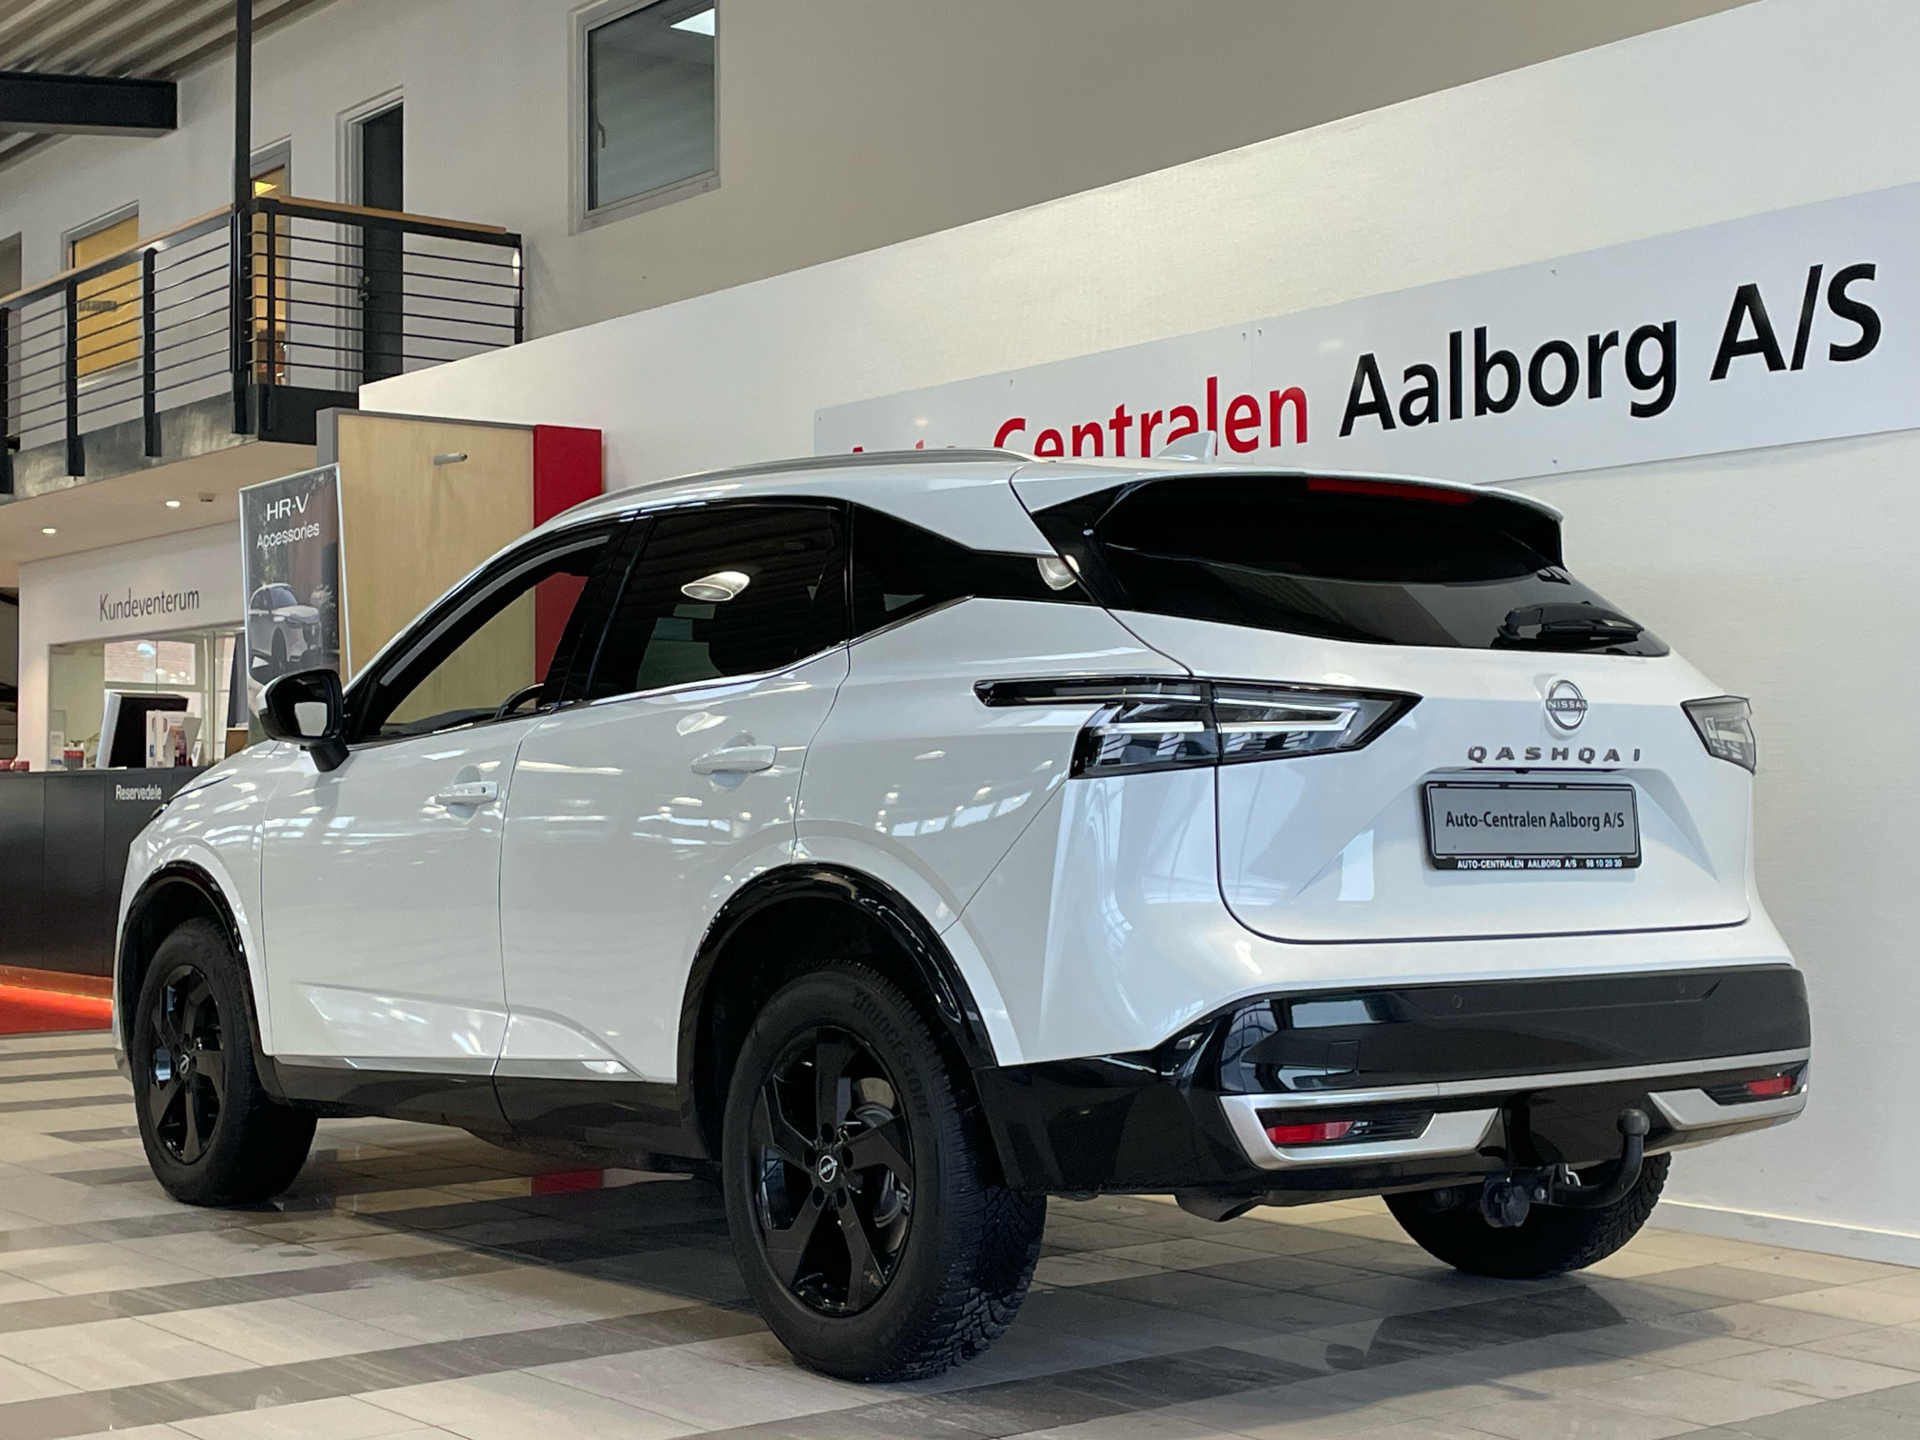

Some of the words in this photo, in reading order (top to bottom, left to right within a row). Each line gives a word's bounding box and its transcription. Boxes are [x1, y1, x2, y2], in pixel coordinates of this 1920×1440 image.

[1338, 319, 1677, 437] Aalborg
[1709, 263, 1882, 381] A/S
[266, 492, 309, 521] HR-V
[256, 522, 320, 549] Accessories
[99, 587, 200, 622] Kundeventerum
[1547, 699, 1587, 710] NISSAN
[1467, 746, 1641, 764] QASHQAI
[115, 784, 162, 800] Reservedele
[1445, 811, 1547, 828] Auto-Centralen
[1549, 811, 1600, 832] Aalborg
[1603, 812, 1625, 828] A/S
[1457, 859, 1525, 869] AUTO-CENTRALEN
[1527, 859, 1562, 868] AALBORG
[1564, 859, 1578, 868] A/S
